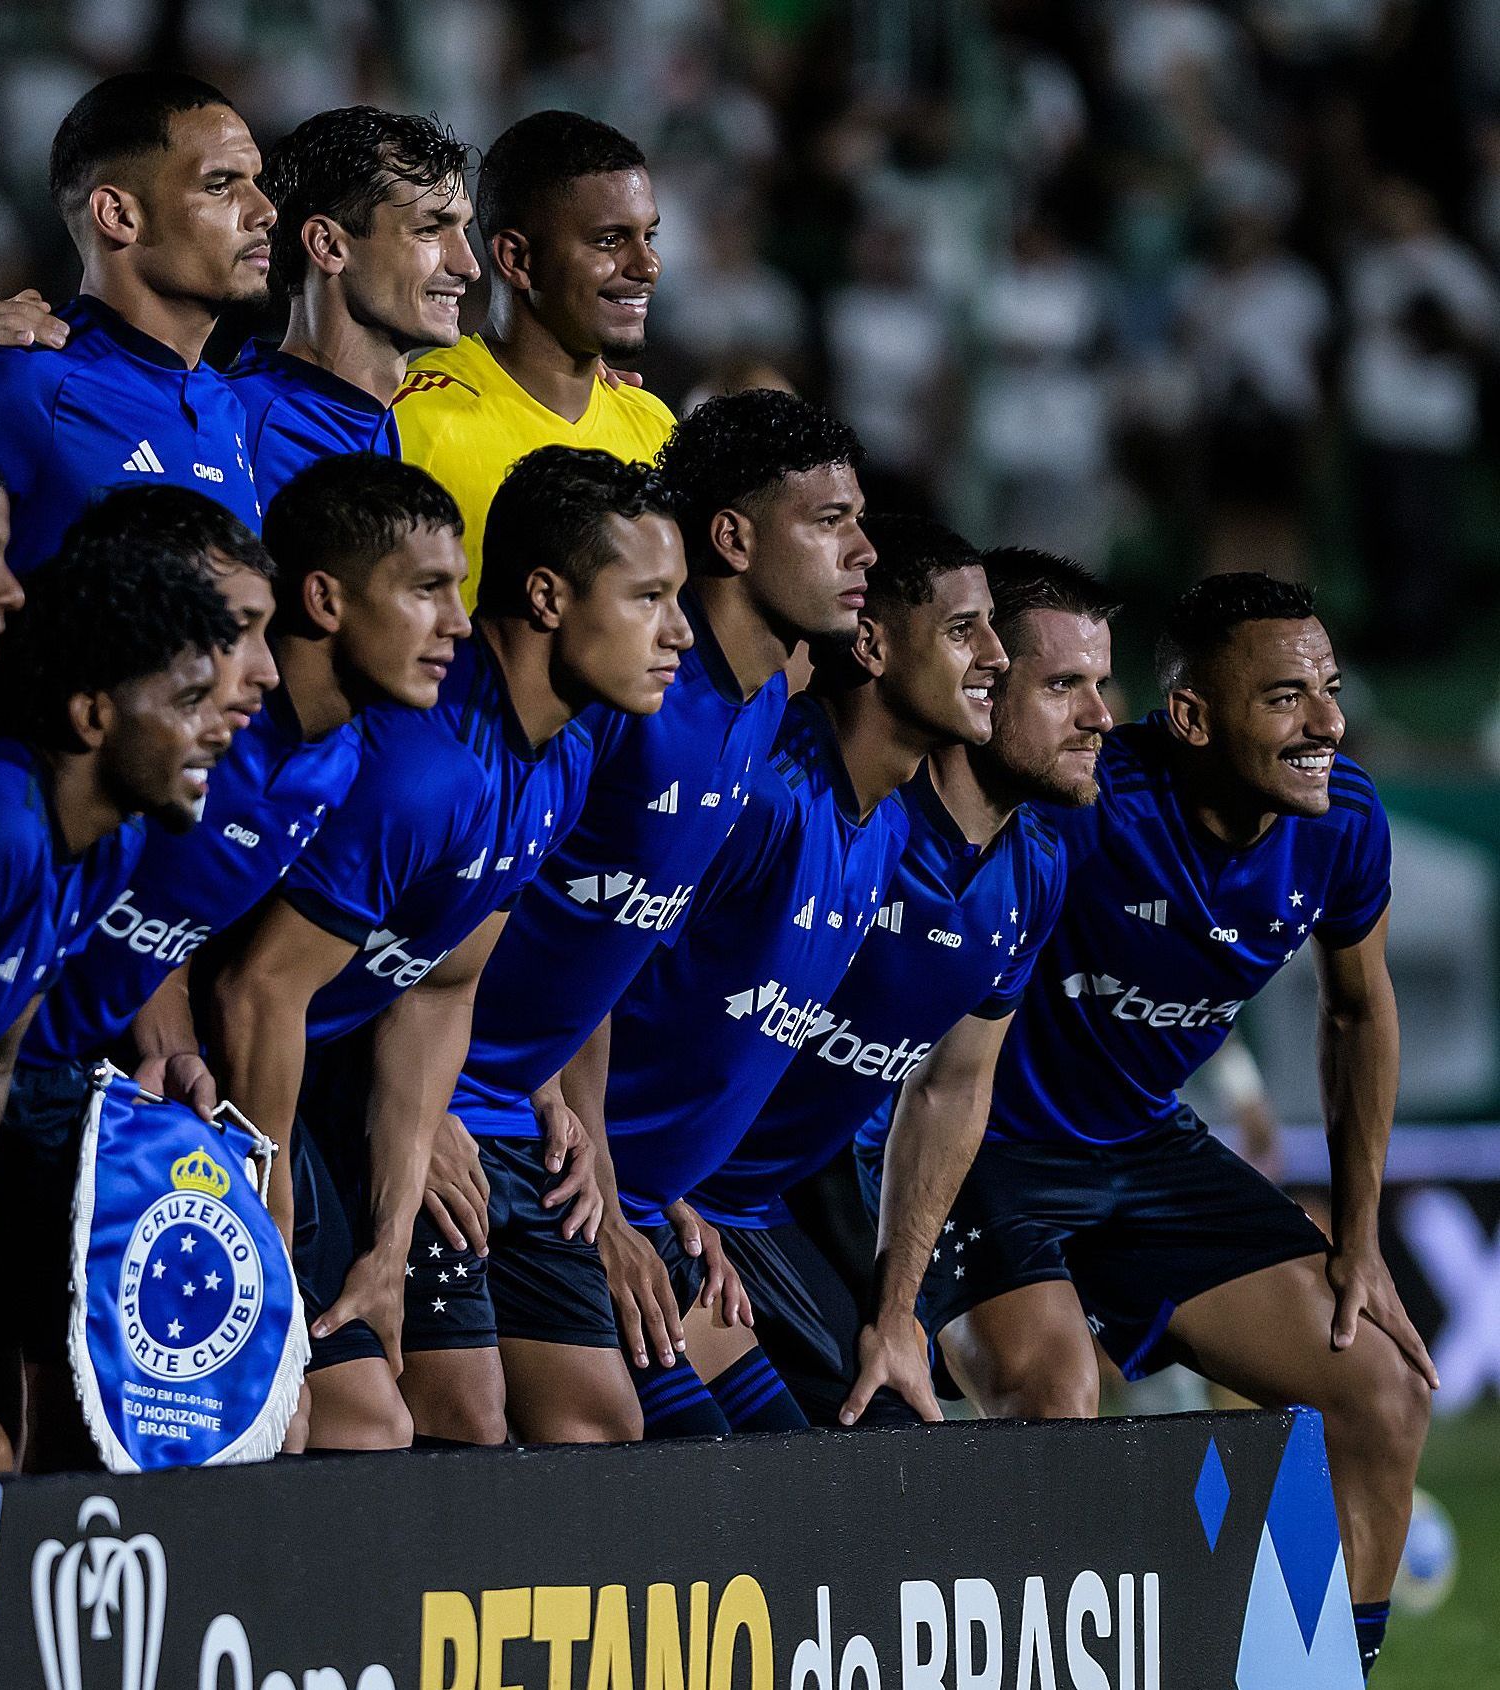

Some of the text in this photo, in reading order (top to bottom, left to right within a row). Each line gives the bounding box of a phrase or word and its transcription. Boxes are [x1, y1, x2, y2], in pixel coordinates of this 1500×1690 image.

[192, 463, 224, 483] CIMED
[927, 928, 962, 949] CIMED
[142, 1200, 249, 1262] CRUZEIRO
[124, 1260, 255, 1372] ESPORTE CLUBE
[156, 1389, 173, 1402] EM
[144, 1404, 222, 1433] HORIZONTE
[136, 1419, 191, 1440] BRASIL
